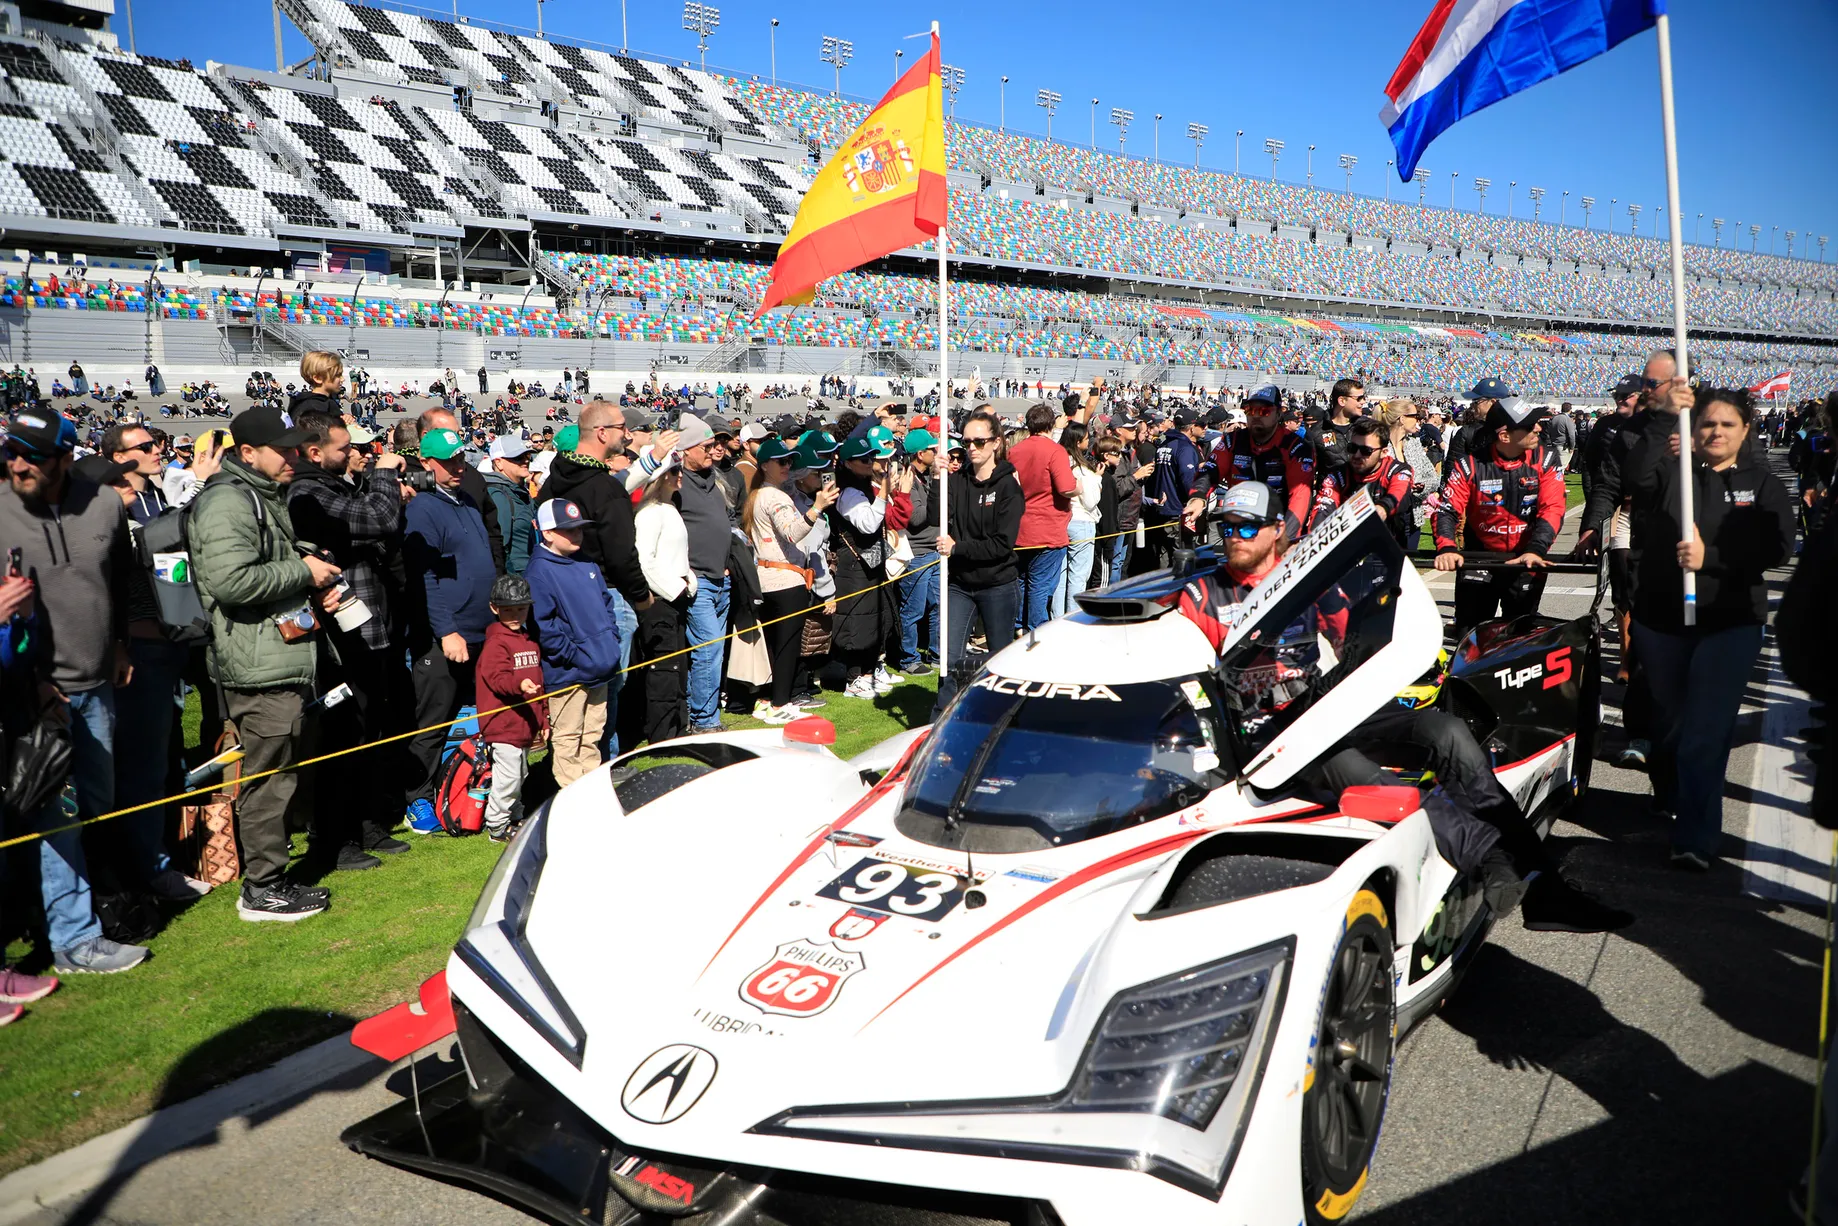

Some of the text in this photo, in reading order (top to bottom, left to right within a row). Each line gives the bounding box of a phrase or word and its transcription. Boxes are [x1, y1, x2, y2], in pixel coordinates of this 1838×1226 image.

[1284, 511, 1345, 569] YELLOLY
[1487, 523, 1529, 535] ACUR
[1232, 601, 1259, 630] VAN
[1264, 569, 1292, 601] DER
[1297, 518, 1351, 570] ZANDE
[973, 675, 1122, 702] ACURA
[1493, 645, 1572, 691] Type S
[838, 861, 958, 916] 93
[784, 946, 855, 973] PHILLIPS
[756, 967, 830, 1004] 66
